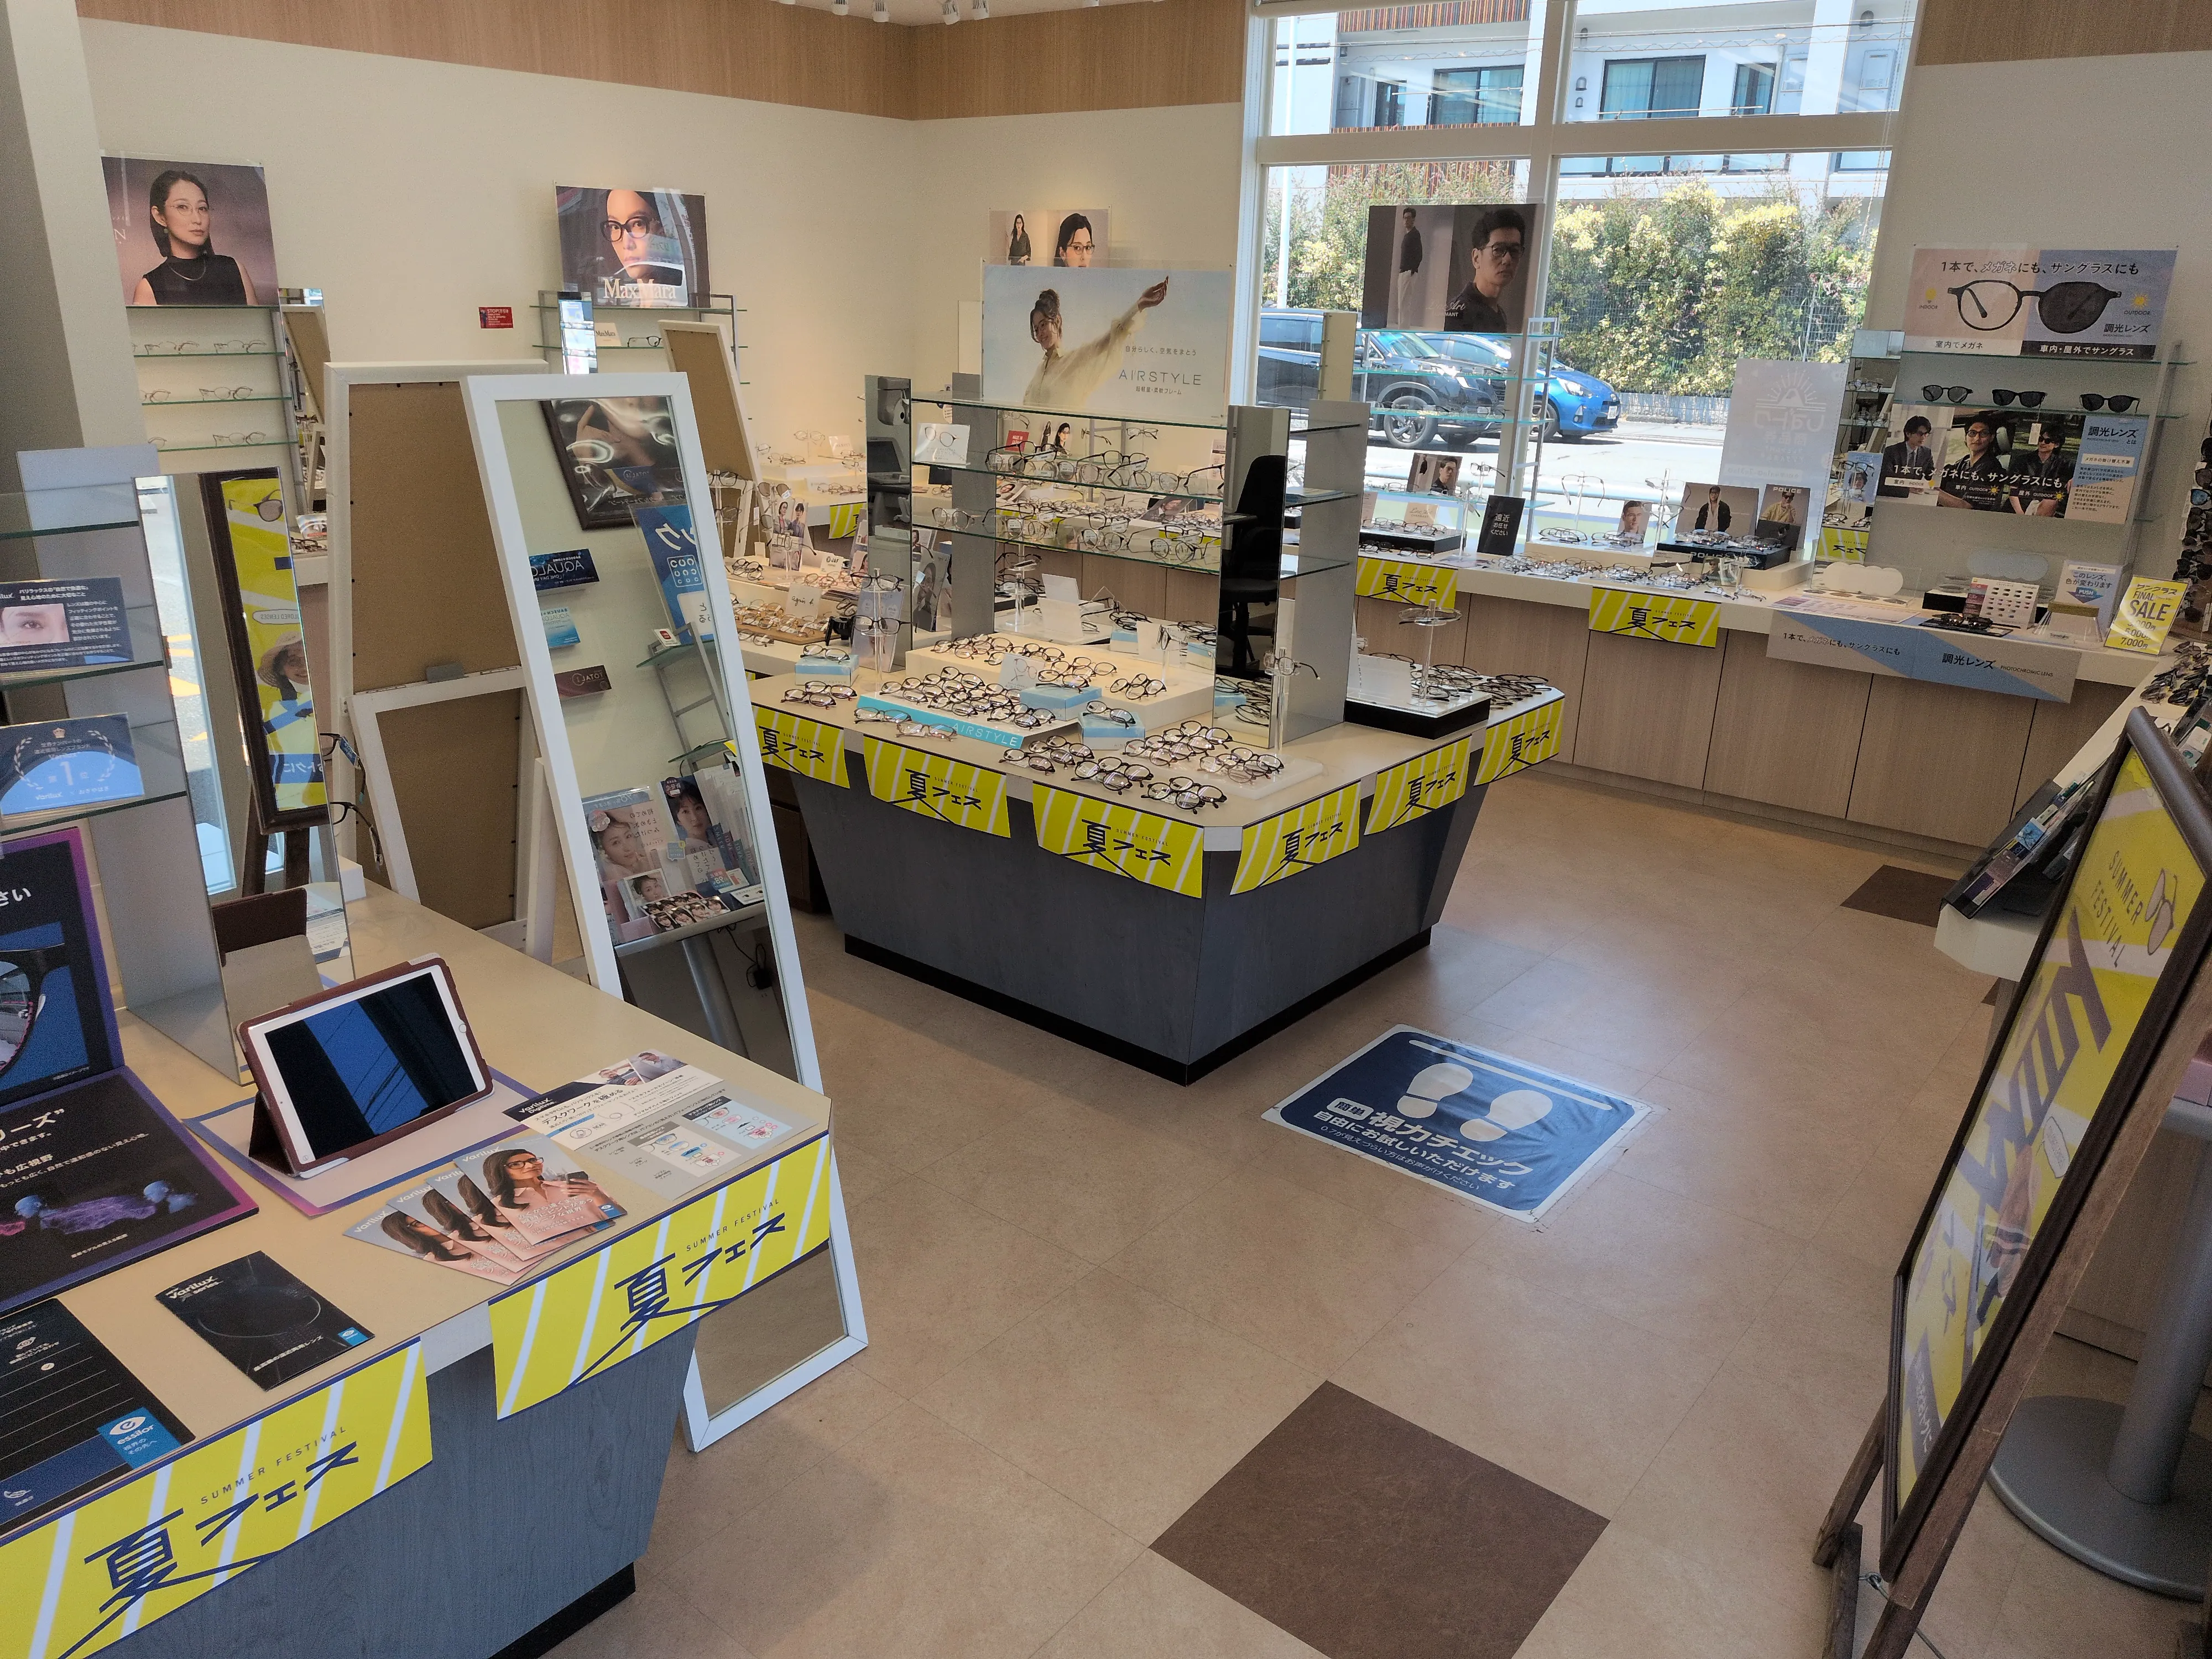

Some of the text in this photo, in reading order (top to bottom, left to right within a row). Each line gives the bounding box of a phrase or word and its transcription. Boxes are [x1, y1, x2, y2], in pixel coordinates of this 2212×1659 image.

[1941, 261, 2139, 275] 1本で、メガネにも、サングラスにも
[603, 278, 676, 299] MaxMara
[2104, 323, 2152, 333] 調光レンズ
[1125, 346, 1197, 356] 自分らしく、空気をまとう
[1934, 340, 1983, 349] 室内でメガネ
[1119, 369, 1202, 385] AIRSTYLE
[2088, 426, 2139, 438] 調光レンズ
[1893, 465, 2063, 488] 1本で、メガネにも、サングラスにも
[1375, 573, 1438, 599] 夏フェス
[2065, 578, 2112, 589] 色が変わります
[2073, 572, 2106, 582] このレンズ、
[2133, 591, 2154, 601] FINAL
[1619, 607, 1696, 635] 夏フェス
[2130, 600, 2171, 622] SALE
[1783, 633, 1901, 656] 1本で、メガネにも、サングラスにも
[2120, 637, 2148, 649] 7,000円
[1942, 653, 1996, 670] 調光レンズ
[2000, 665, 2040, 676] PHOTOCHROMIC
[952, 722, 1018, 747] AIRSTYLE
[759, 726, 825, 769] 夏フェス
[1501, 730, 1550, 771] 夏フェス
[934, 776, 954, 786] SUMMER
[897, 769, 982, 817] 夏フェス
[1397, 771, 1456, 818] 夏フェス
[1072, 819, 1171, 874] 夏フェス
[1116, 828, 1169, 847] SUMMER FESTIVAL
[1270, 821, 1343, 875] 夏フェス
[2109, 851, 2143, 925] SUMMER
[2091, 879, 2125, 968] FESTIVAL
[518, 1097, 553, 1115] Varilux
[1334, 1101, 1366, 1117] 簡単
[461, 1146, 501, 1162] Varilux
[1313, 1110, 1516, 1190] 自由にお試しいただけます
[1369, 1111, 1533, 1176] 視力チェック
[518, 1196, 580, 1220] 近くから遠くまで
[354, 1210, 389, 1234] Varilux
[686, 1198, 780, 1251] SUMMER FESTIVAL
[168, 1275, 218, 1300] Varilux
[594, 1212, 786, 1358] 夏フェス
[117, 1424, 155, 1445] essilor
[201, 1426, 347, 1505] SUMMER FESTIVAL
[67, 1440, 359, 1636] 夏フェス
